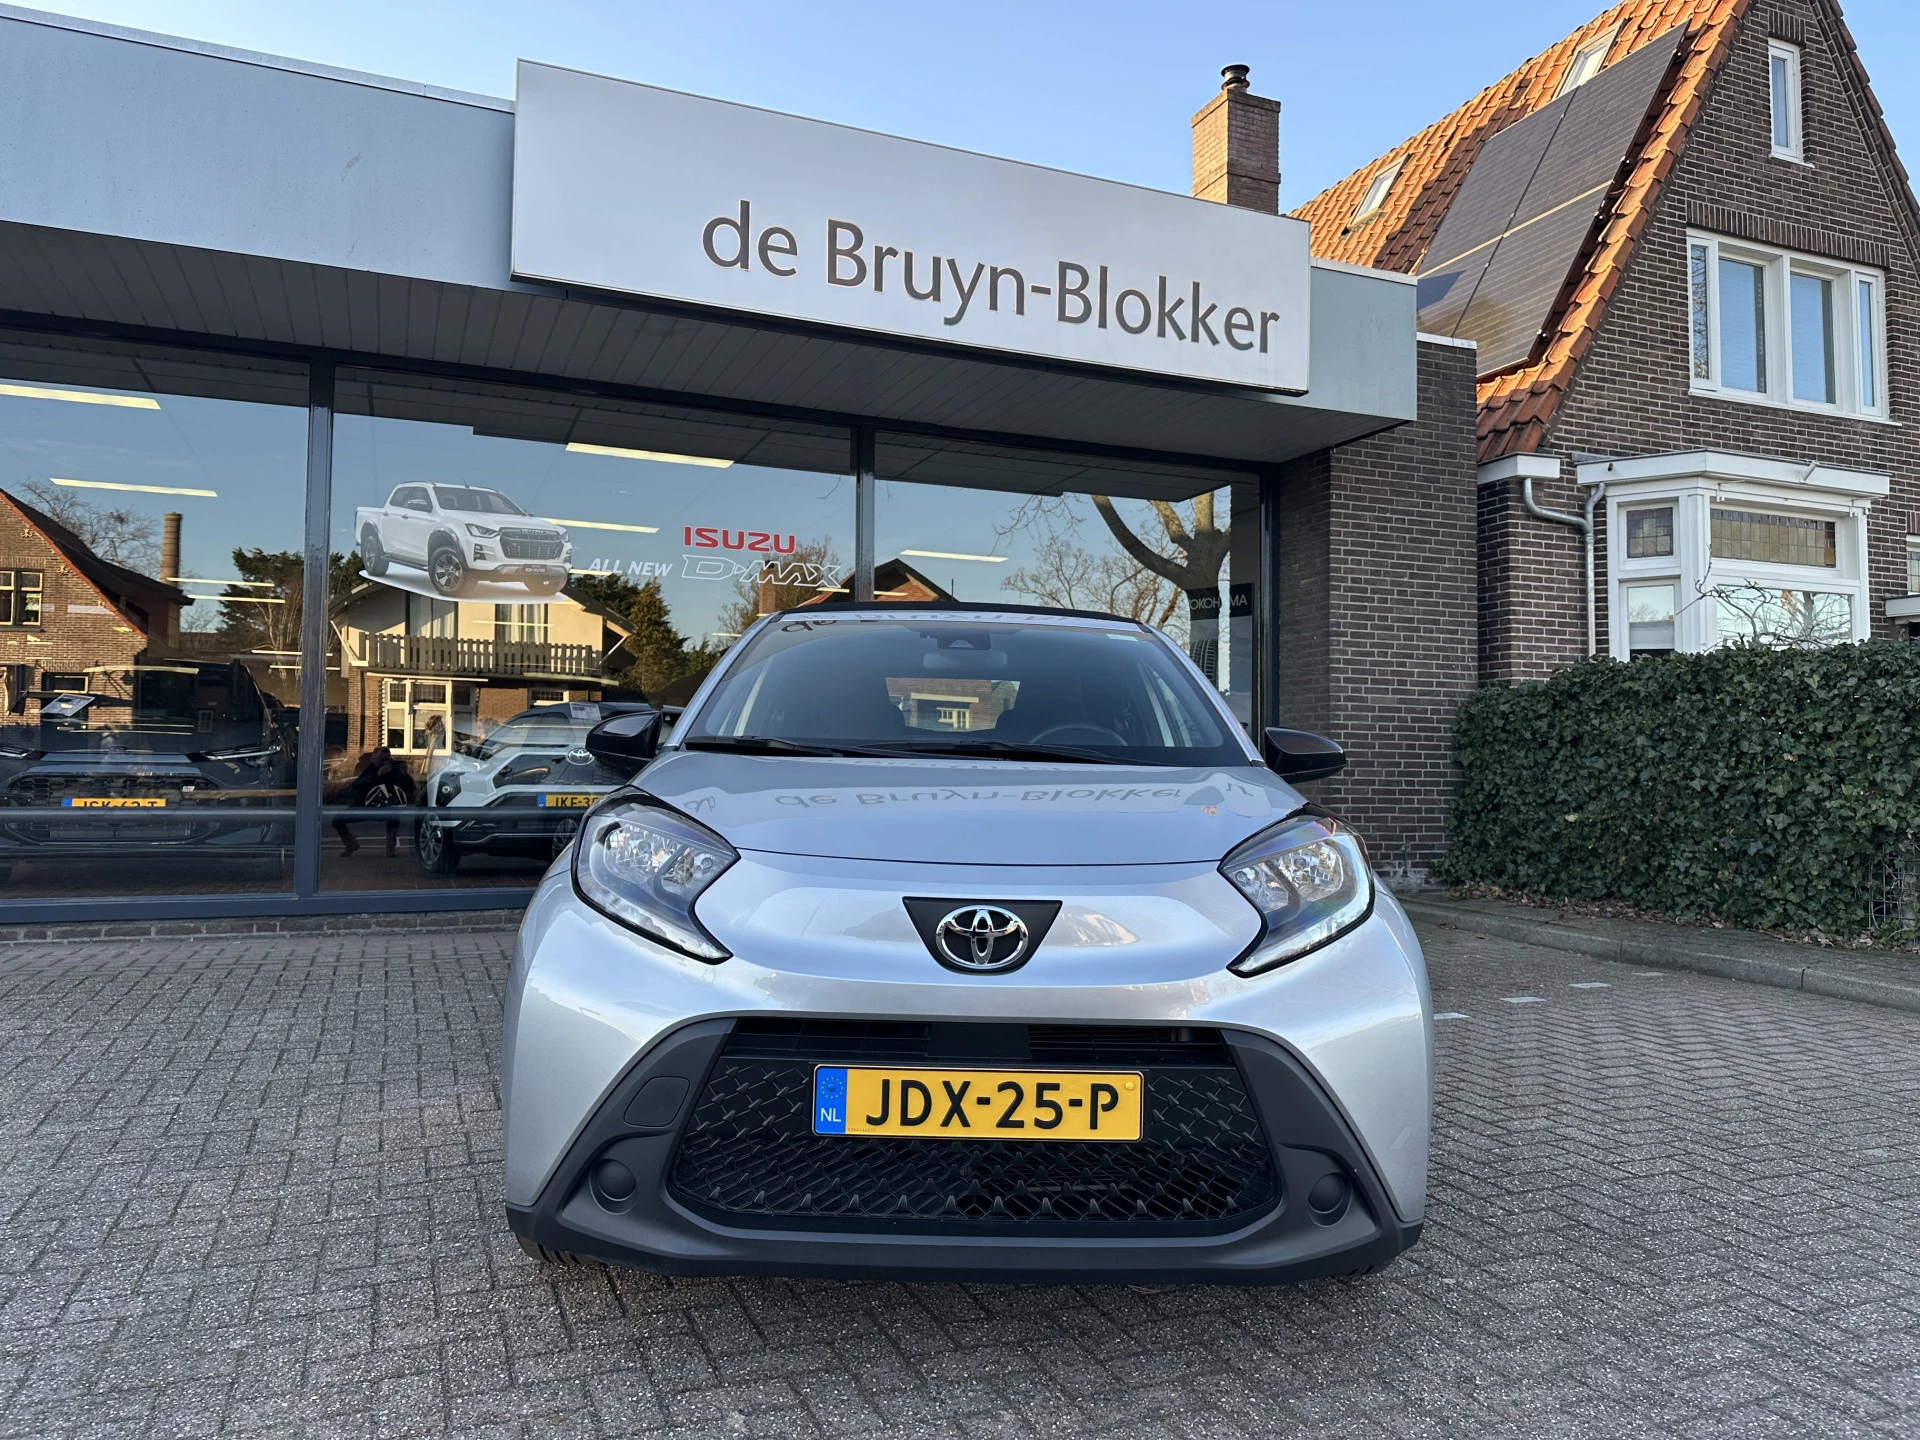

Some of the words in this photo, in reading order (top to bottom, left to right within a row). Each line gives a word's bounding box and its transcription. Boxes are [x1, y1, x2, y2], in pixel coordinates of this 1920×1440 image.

[702, 199, 799, 278] de
[826, 217, 1281, 354] Bruyn-Blokker
[683, 526, 796, 554] ISUZU
[588, 557, 623, 575] ALL
[627, 560, 673, 577] NEW
[1187, 594, 1248, 610] OKOHMA
[820, 1107, 842, 1122] NL
[865, 1078, 1119, 1130] JDX-25-P
